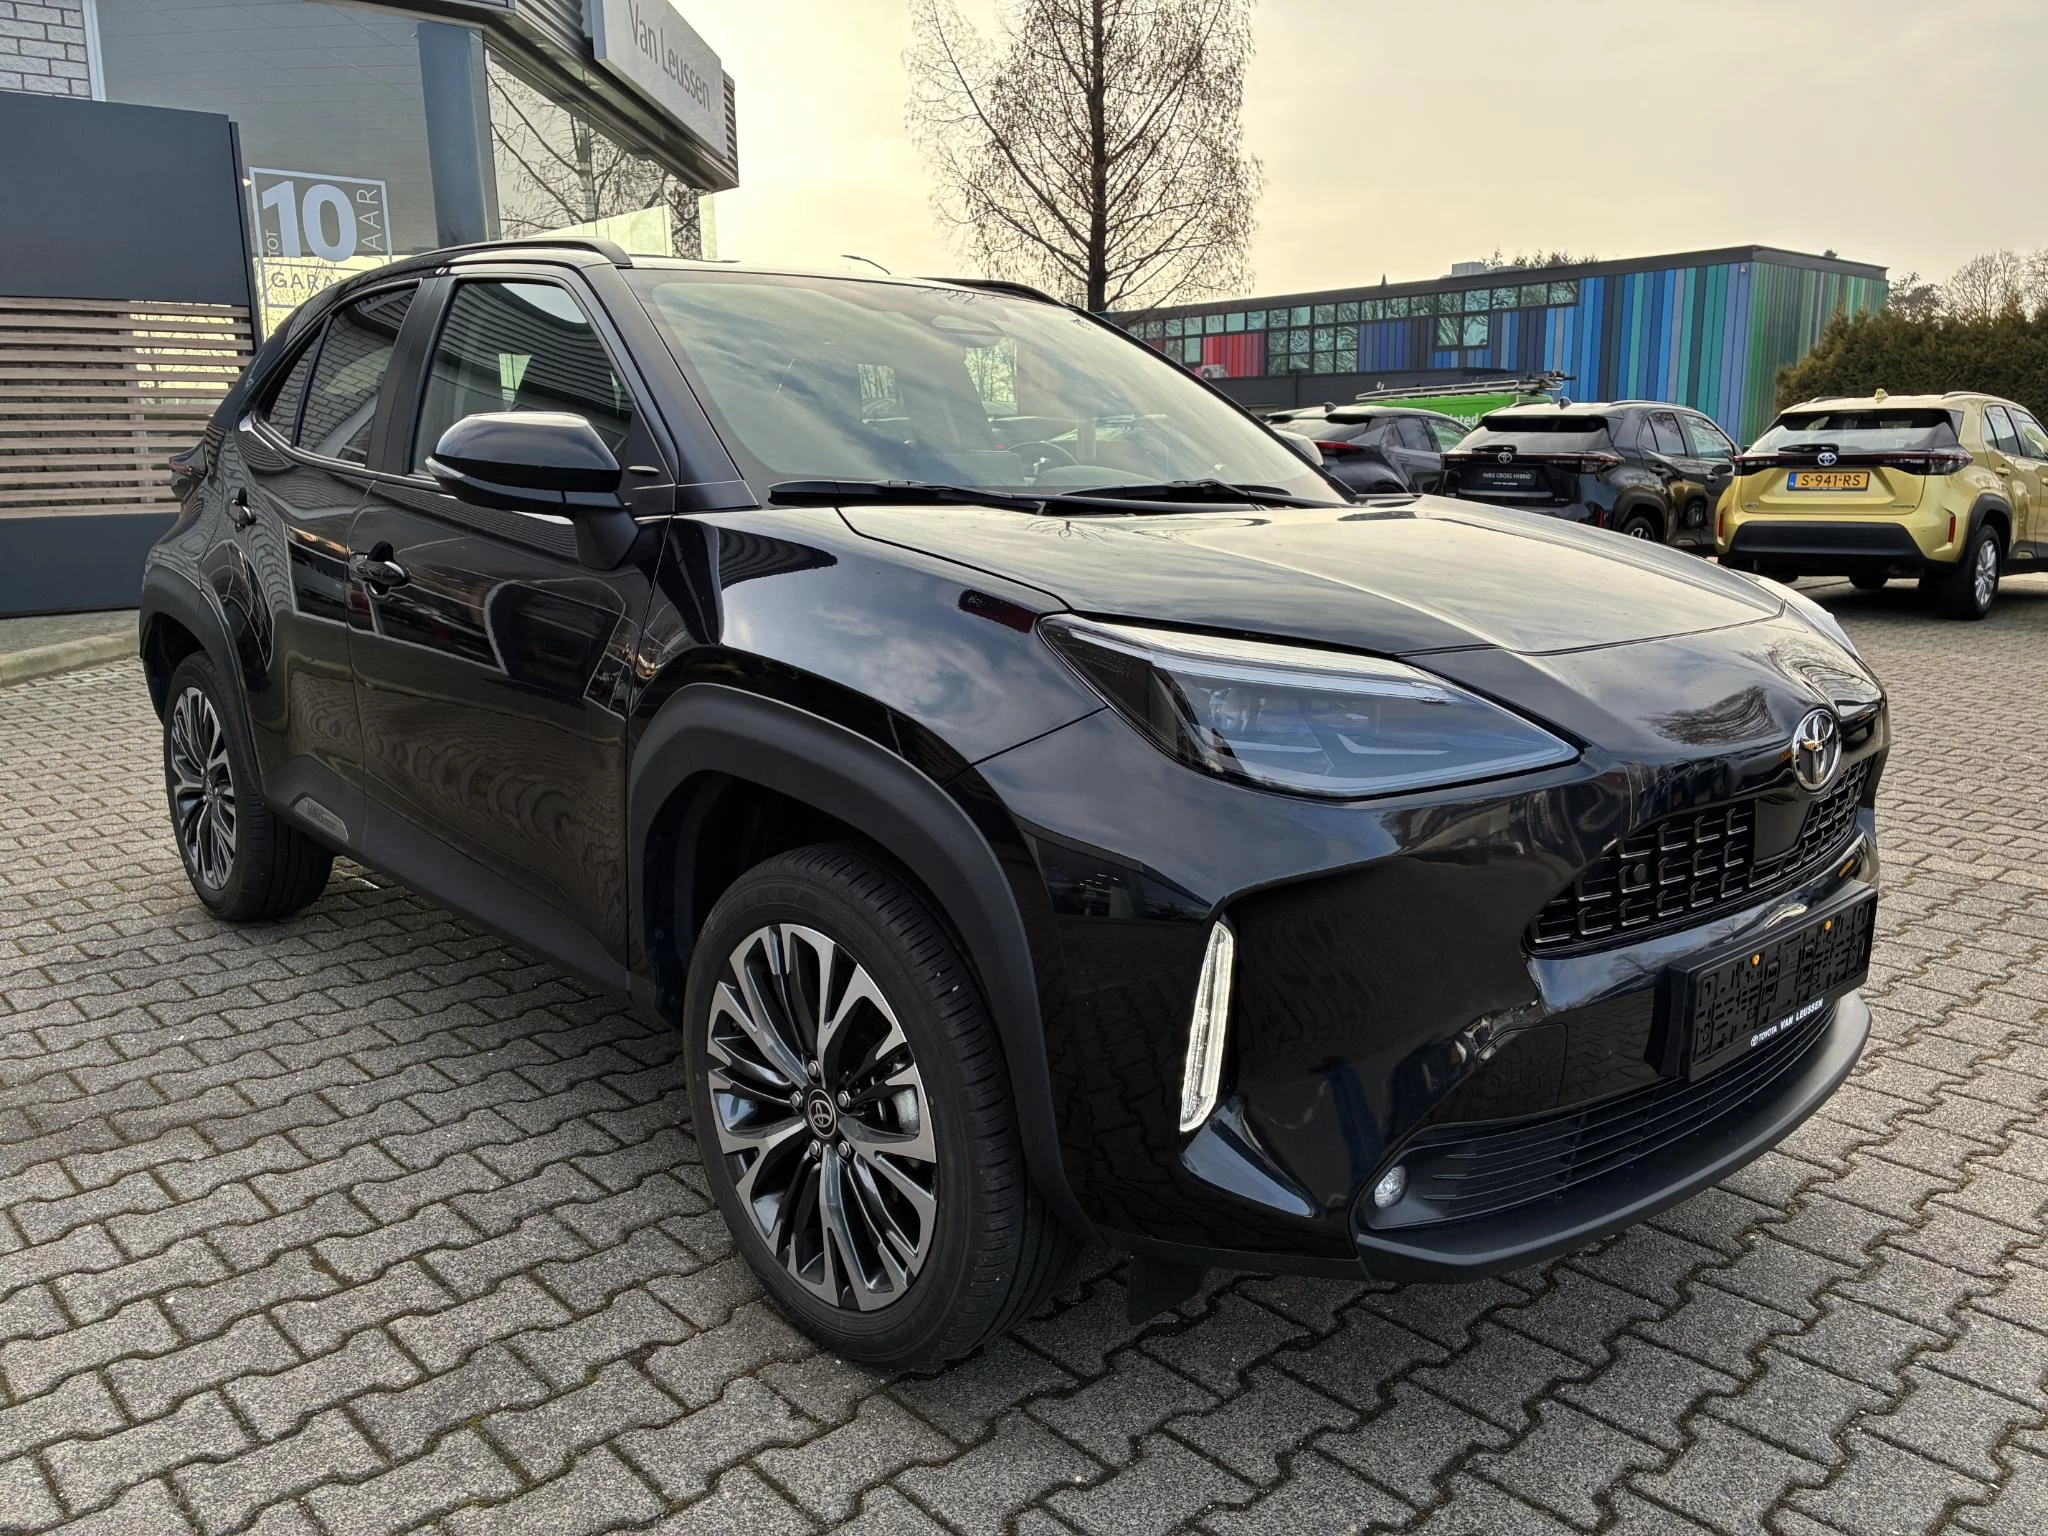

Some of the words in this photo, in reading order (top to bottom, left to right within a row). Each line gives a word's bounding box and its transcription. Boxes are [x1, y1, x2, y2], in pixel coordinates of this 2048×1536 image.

[628, 0, 658, 64] Van
[660, 27, 711, 112] Leussen
[262, 180, 357, 262] 10
[265, 229, 280, 258] TOT
[271, 271, 342, 291] GARA
[1801, 474, 1861, 487] S-941-RS
[1758, 1025, 1778, 1042] TOYOTA
[1780, 1015, 1794, 1030] VAN
[1795, 997, 1824, 1021] LEUSSEN
